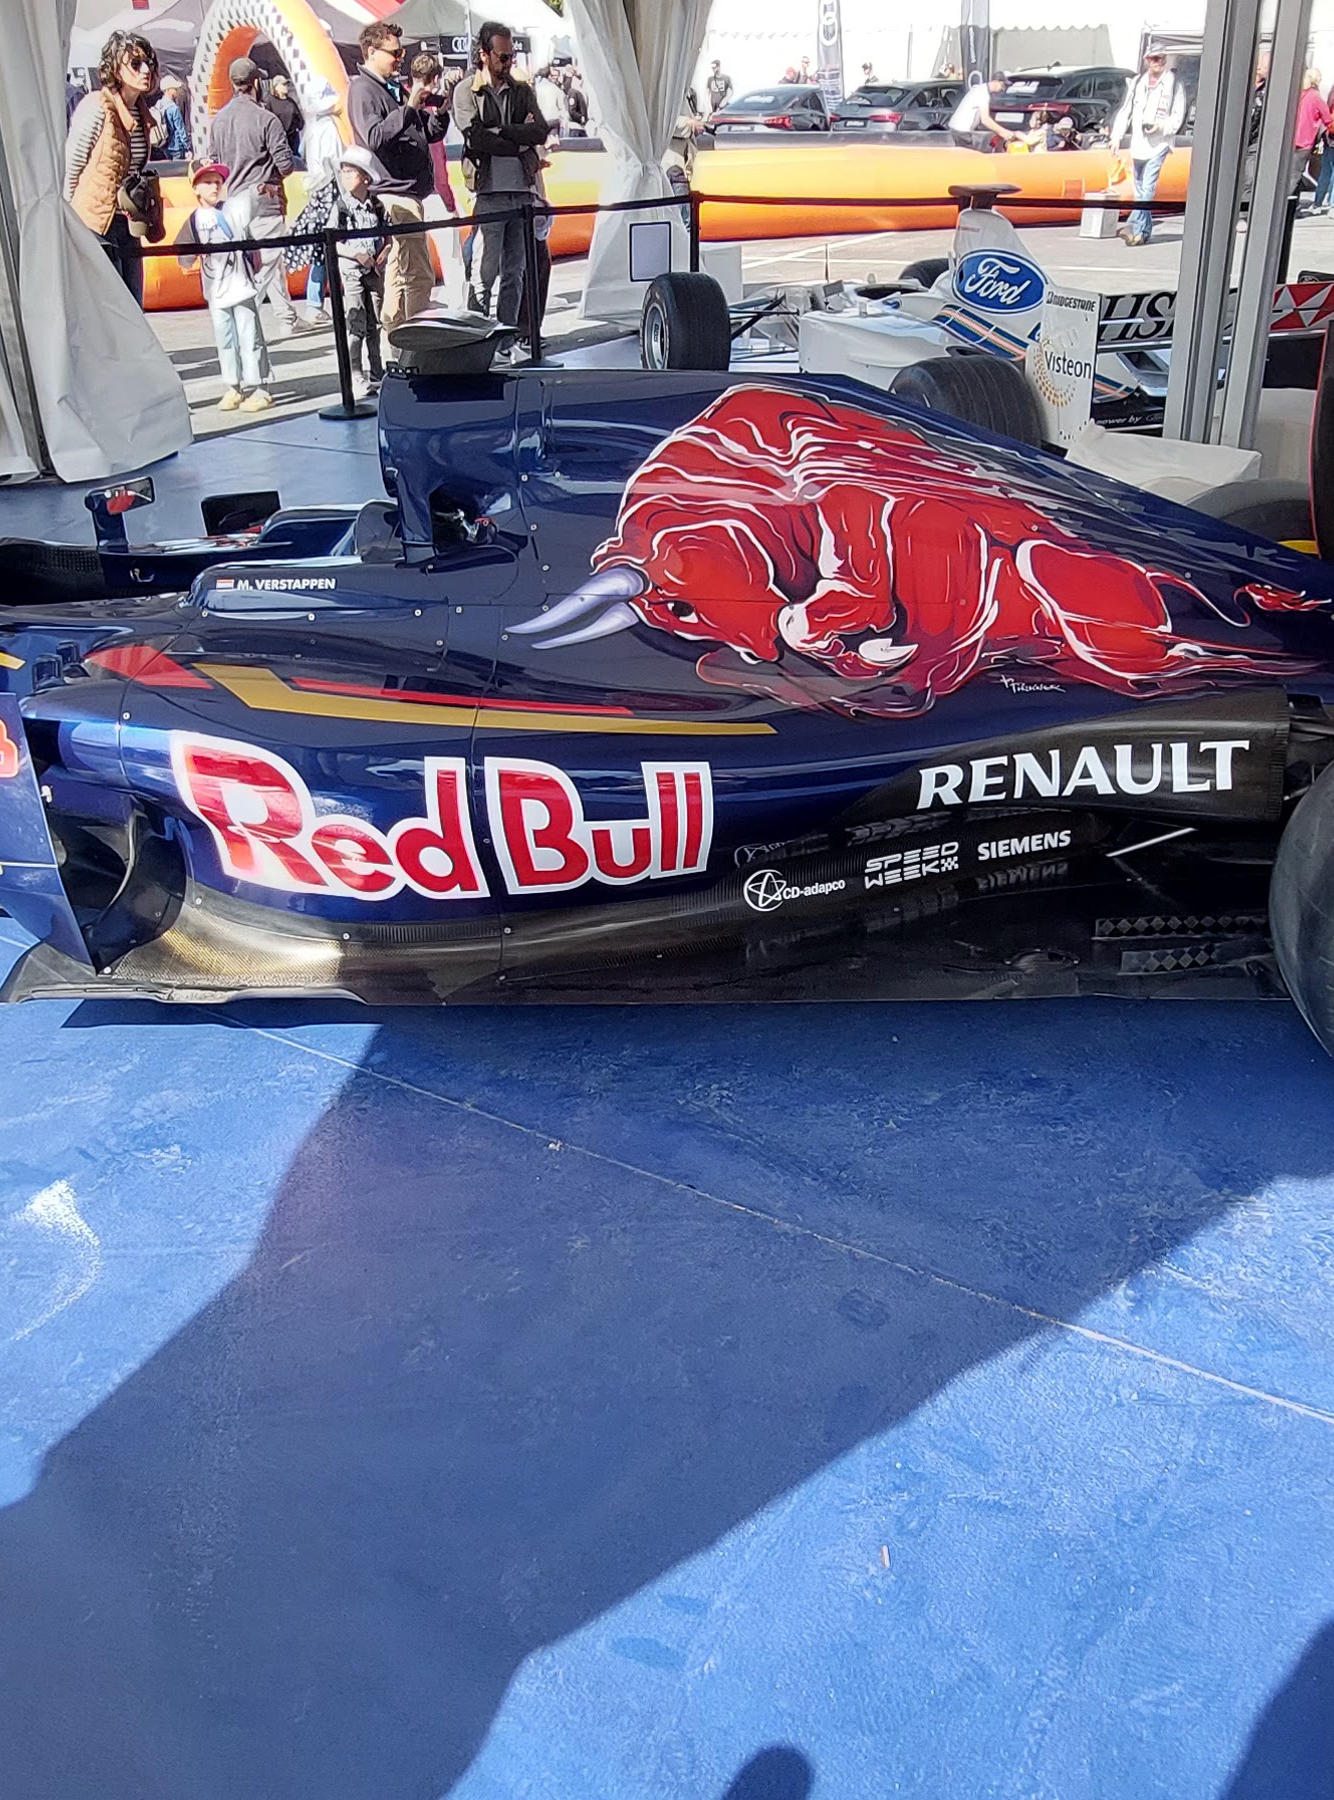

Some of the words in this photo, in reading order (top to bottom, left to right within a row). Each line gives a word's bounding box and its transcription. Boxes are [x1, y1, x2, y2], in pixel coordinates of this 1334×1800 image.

[963, 257, 1031, 305] Ford
[1045, 291, 1097, 313] BRIDGESTONE
[1044, 350, 1093, 380] Visteon
[236, 579, 254, 592] M.
[254, 577, 336, 592] VERSTAPPEN
[916, 739, 1251, 810] RENAULT
[172, 731, 489, 899] Red
[485, 757, 712, 894] Bull
[864, 841, 960, 873] SPEED
[977, 829, 1072, 862] SIEMENS
[782, 877, 846, 901] CD-adapco
[864, 862, 941, 890] WEEK
